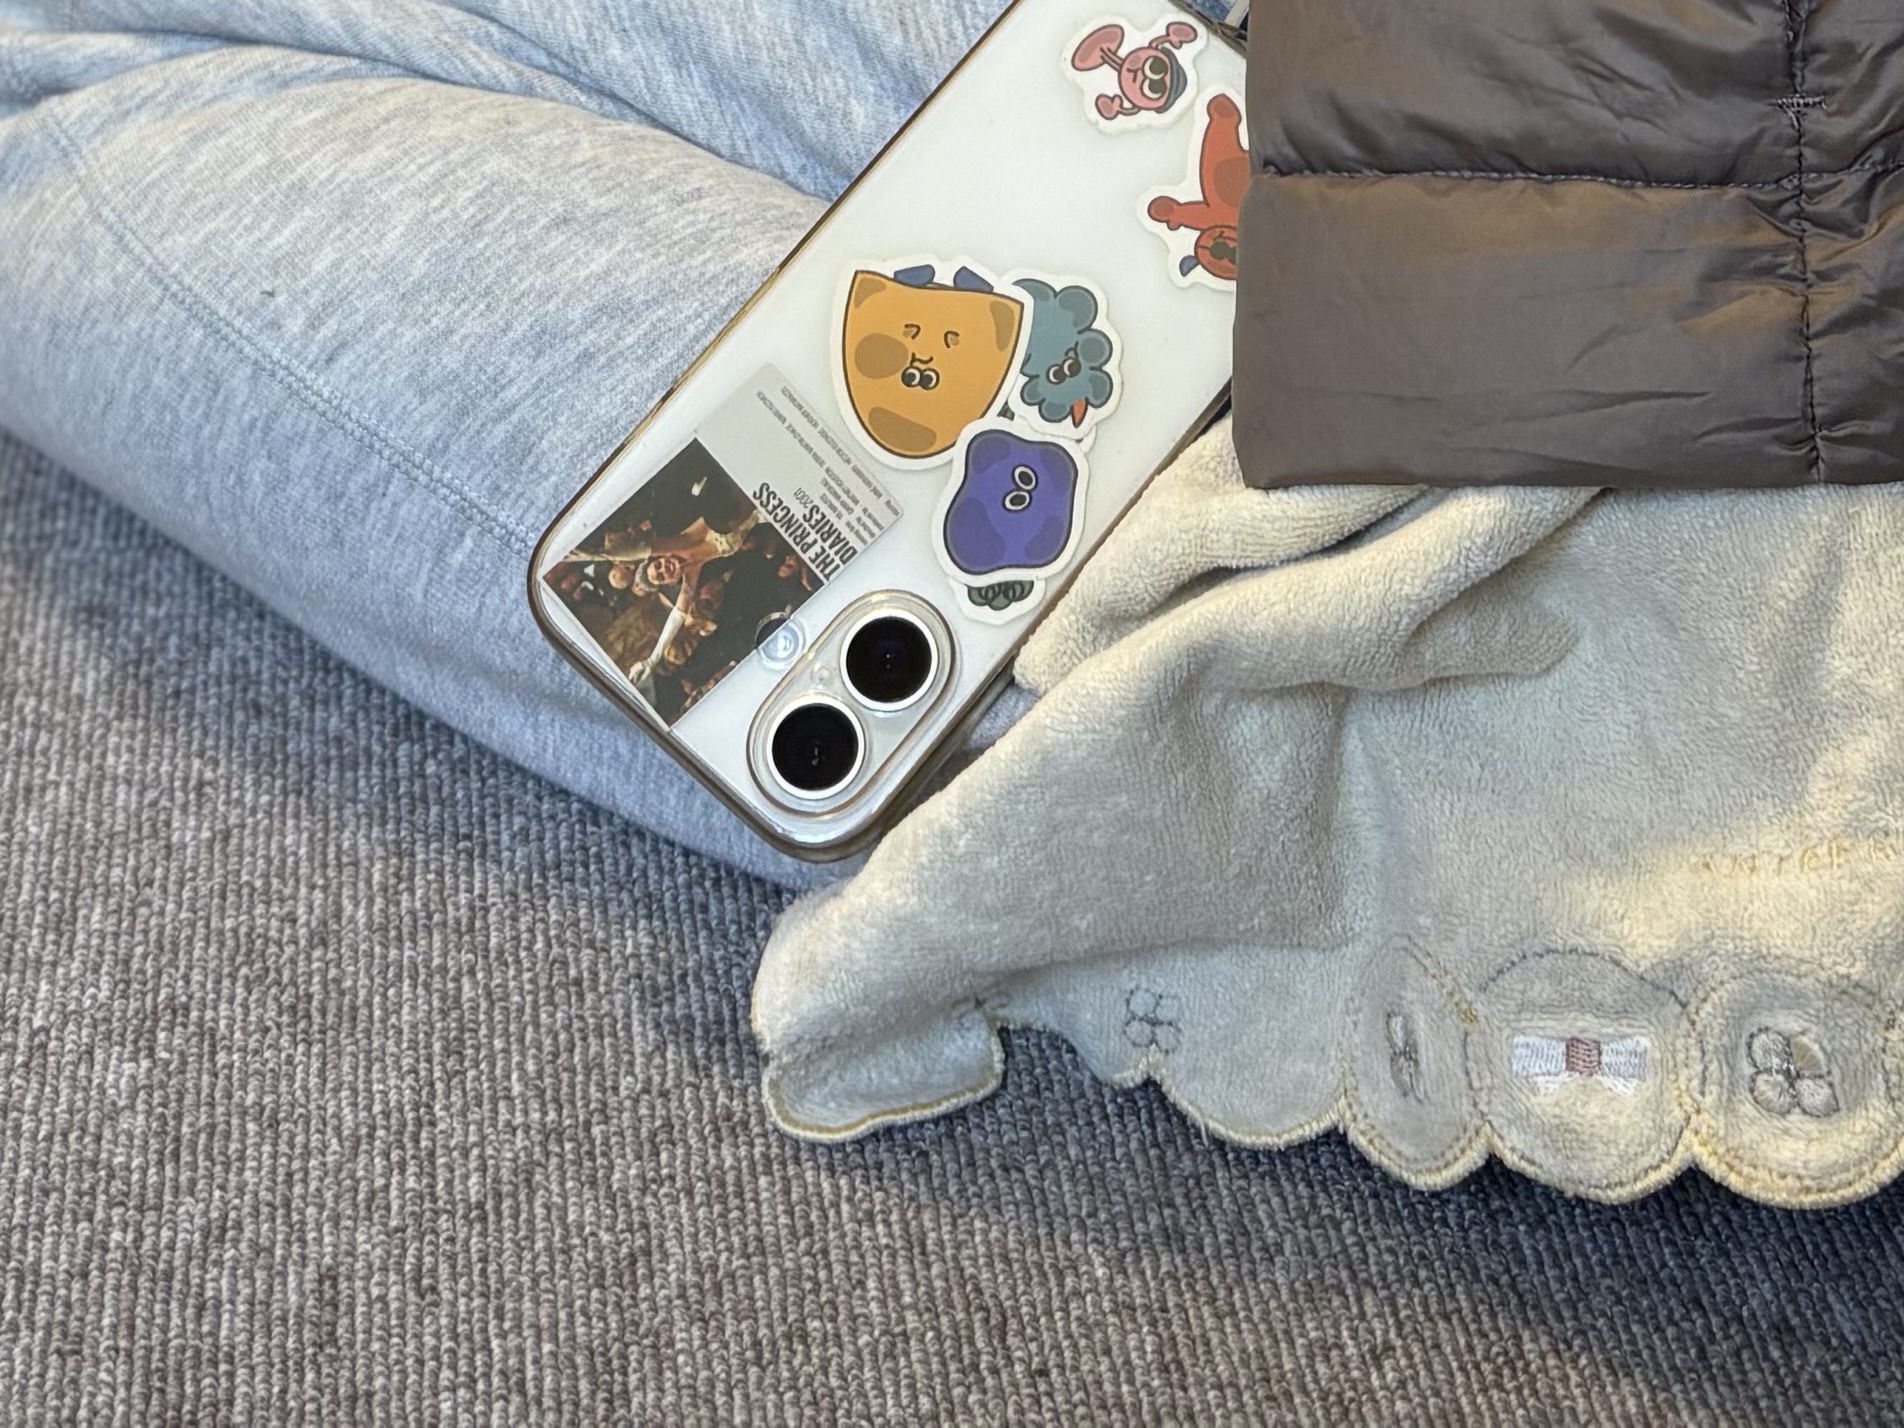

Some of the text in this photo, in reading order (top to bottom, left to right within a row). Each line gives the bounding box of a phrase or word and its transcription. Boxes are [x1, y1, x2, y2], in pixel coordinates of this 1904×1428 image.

[751, 482, 819, 555] PRINCESS
[792, 487, 815, 510] 2001
[801, 504, 858, 565] DIARIES
[807, 545, 841, 581] THE
